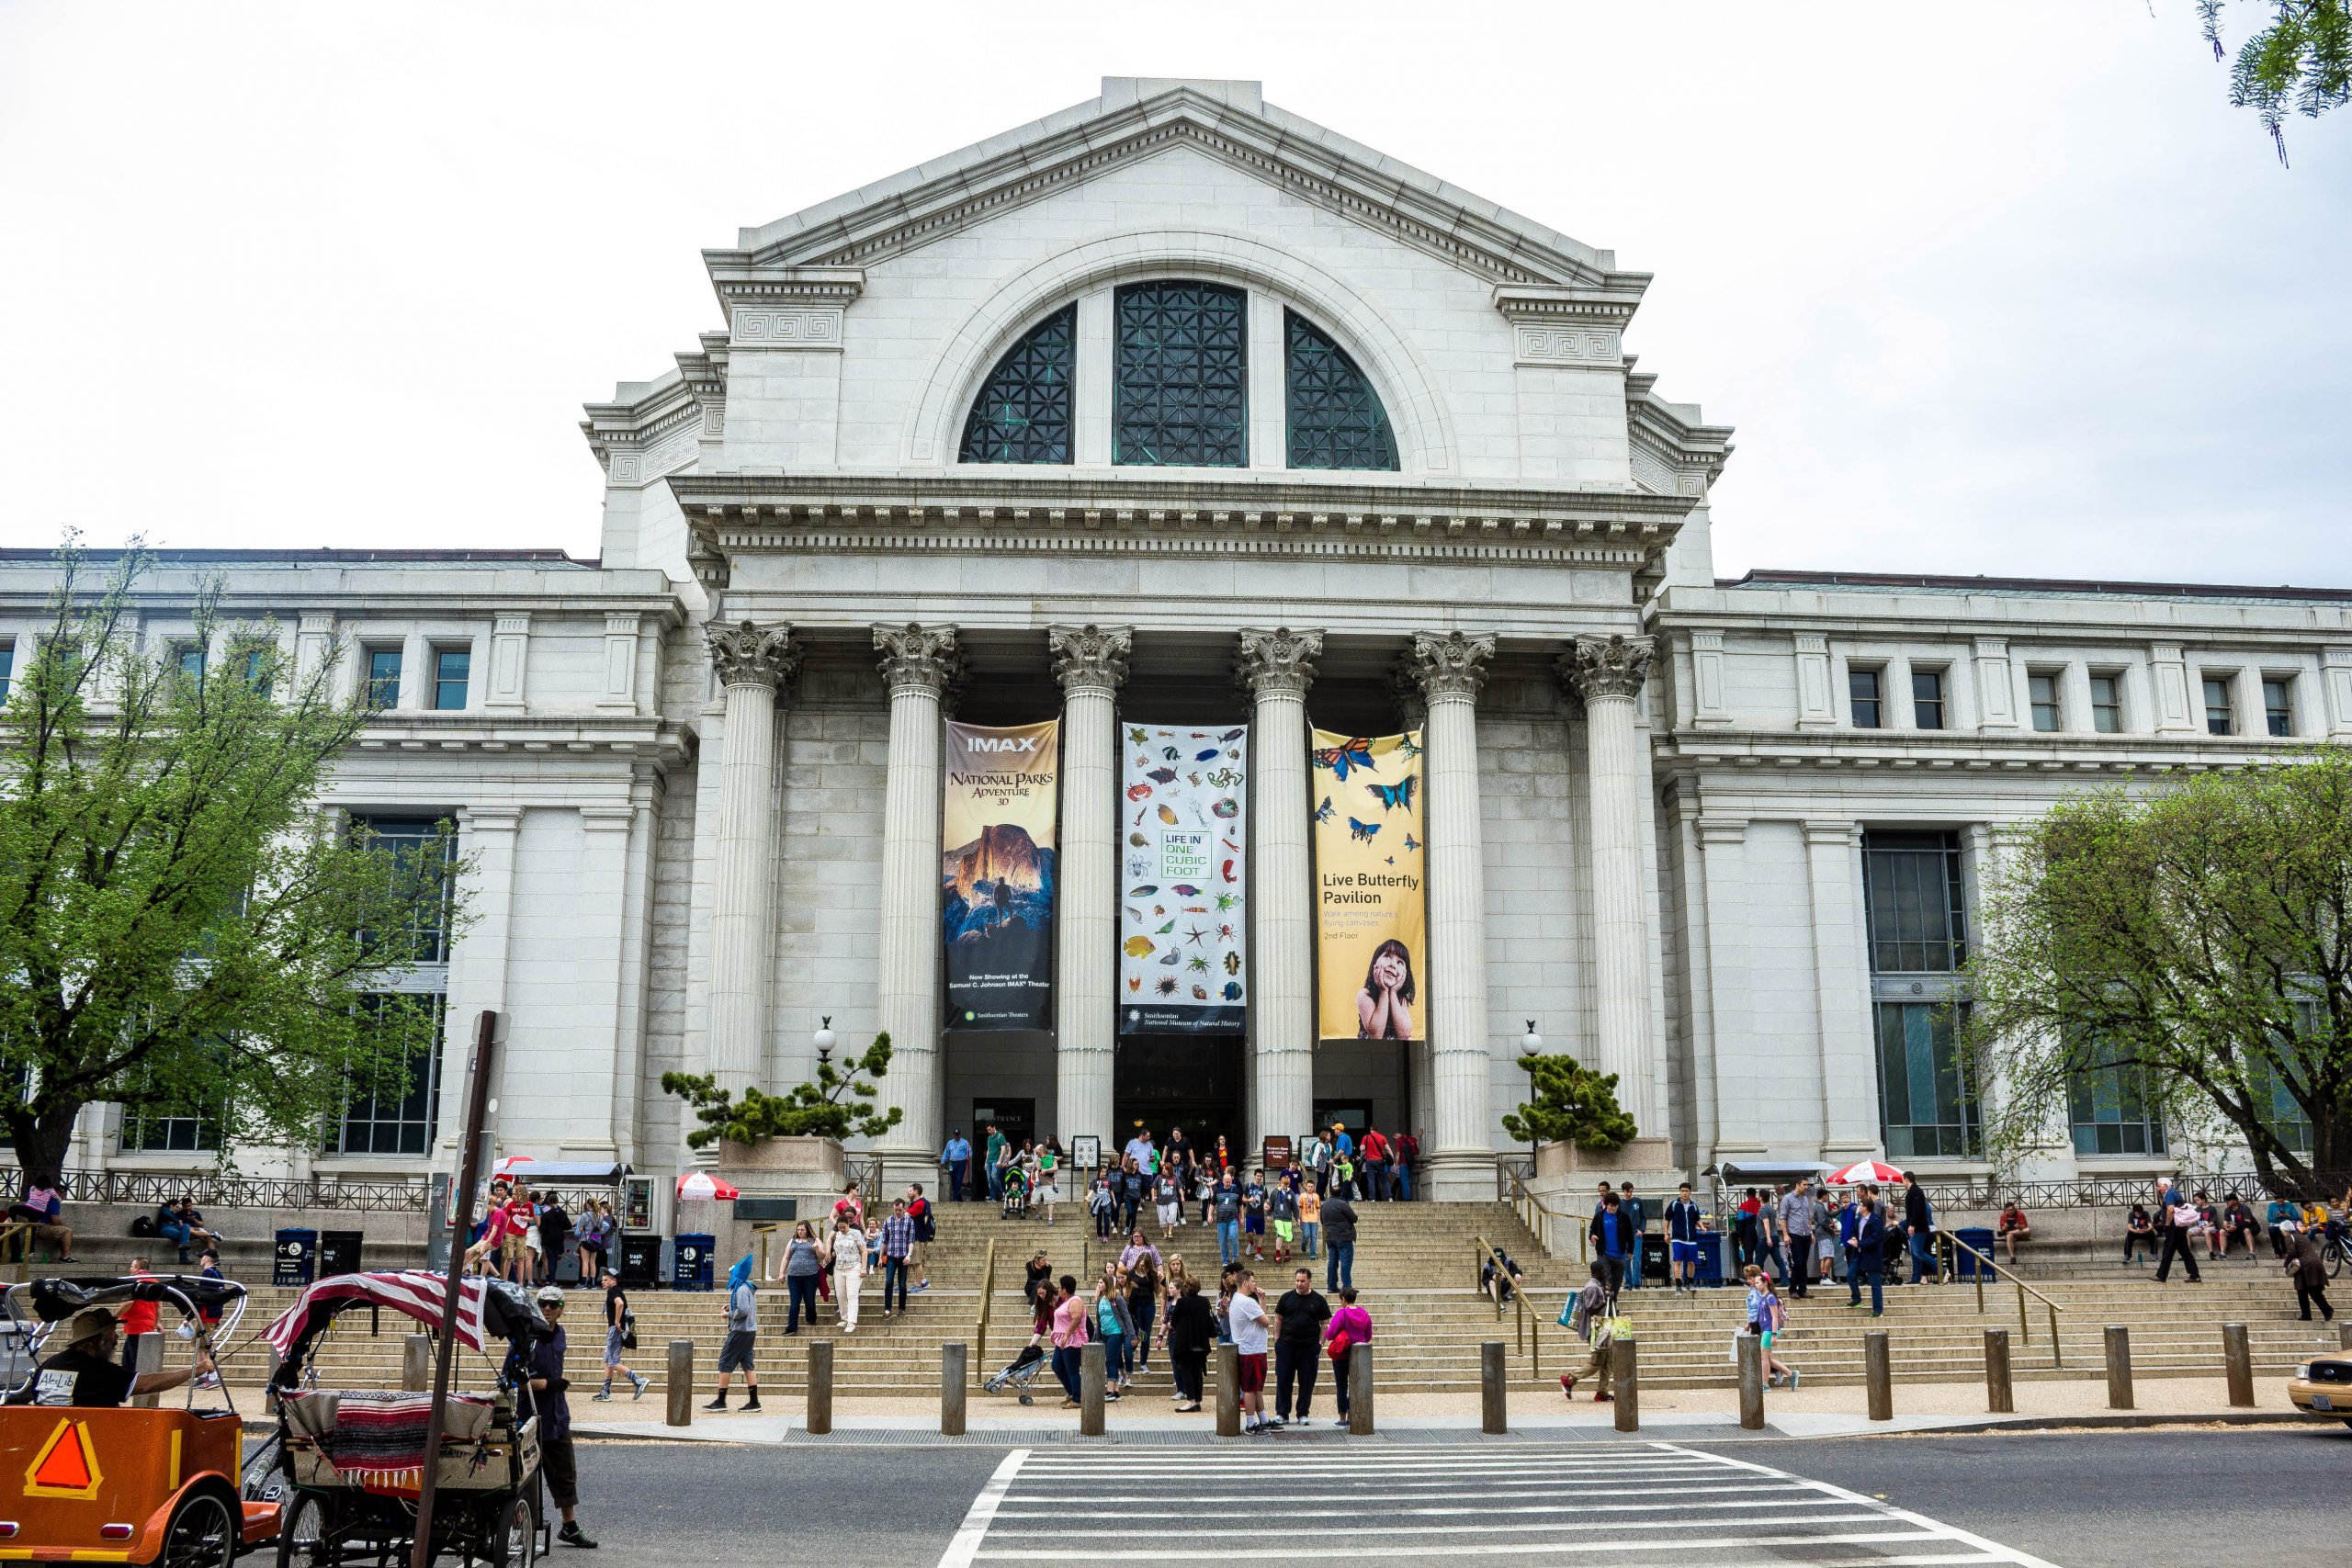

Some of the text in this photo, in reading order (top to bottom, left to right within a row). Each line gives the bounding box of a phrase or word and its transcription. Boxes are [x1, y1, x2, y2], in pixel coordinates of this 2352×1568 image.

[968, 738, 1036, 752] IMAX
[1166, 835, 1201, 844] LIFE IN
[1166, 845, 1193, 853] ONE
[1166, 856, 1206, 865] CUBIC
[1166, 867, 1200, 875] FOOT
[1323, 874, 1419, 891] Live Butterfly
[1323, 891, 1381, 904] Pavilion
